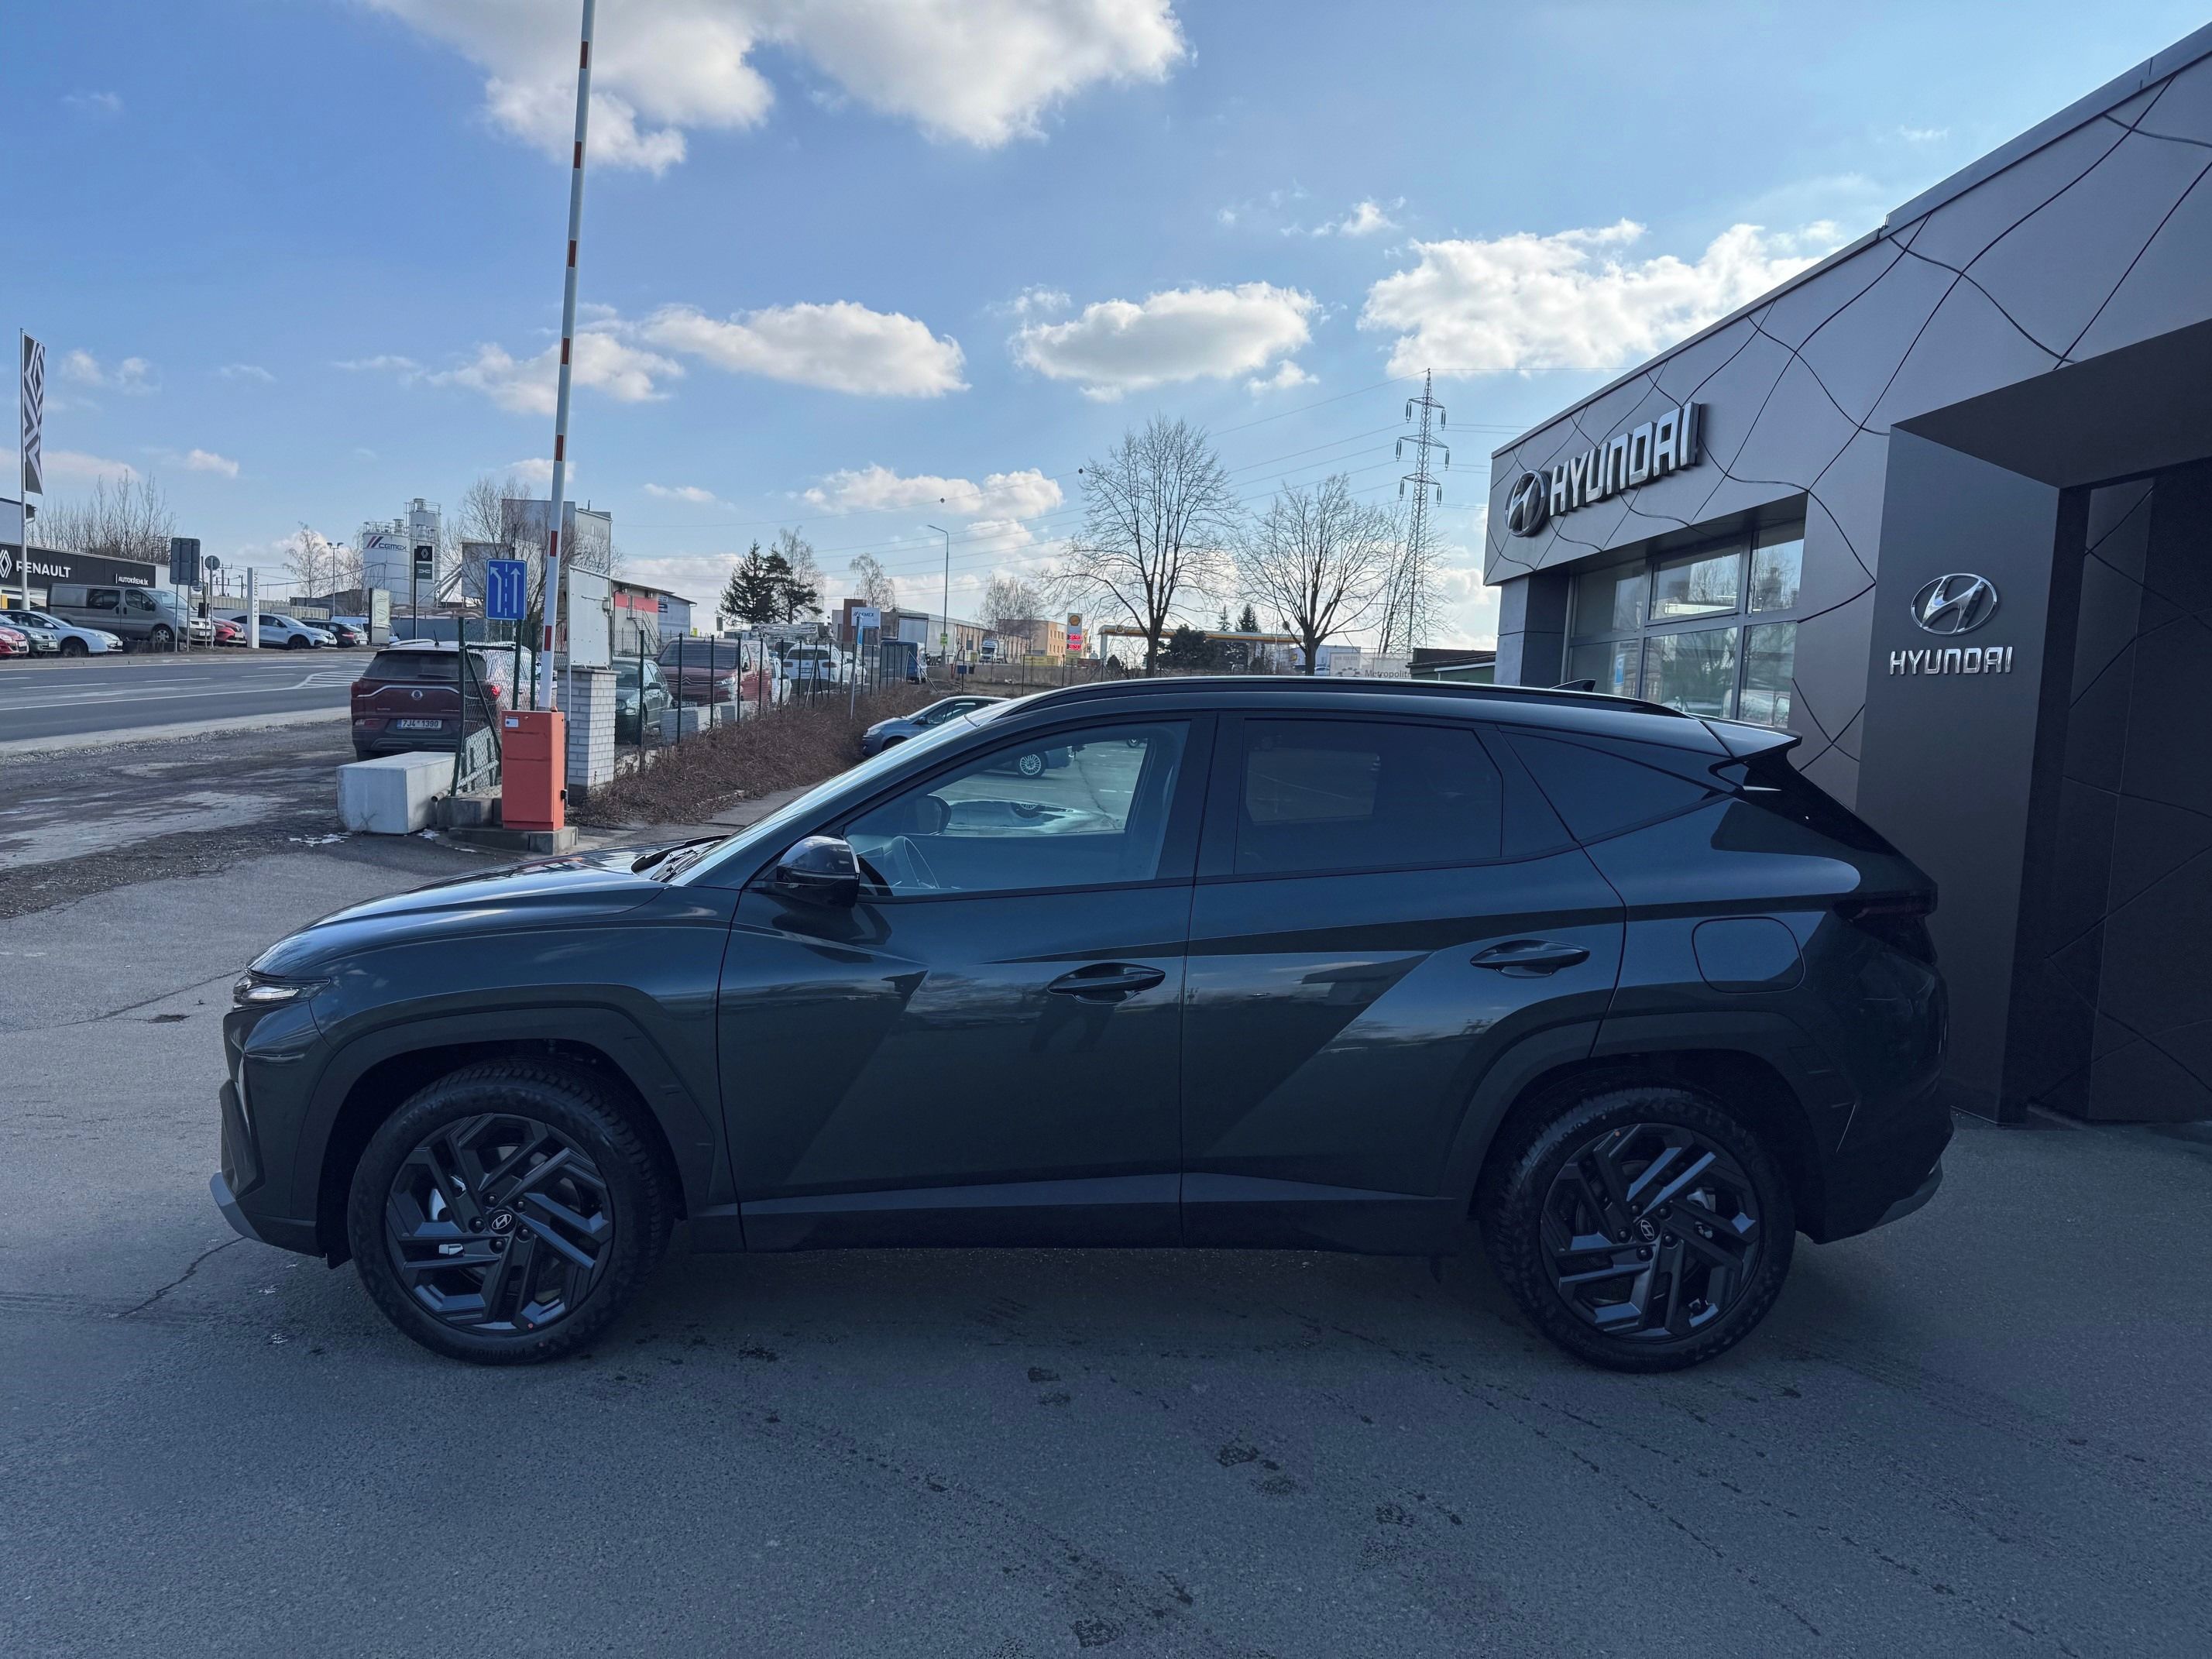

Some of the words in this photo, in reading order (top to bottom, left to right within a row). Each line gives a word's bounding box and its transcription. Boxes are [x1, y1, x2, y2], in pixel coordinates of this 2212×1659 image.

[1550, 402, 1698, 516] HYUNDAI
[16, 560, 71, 579] RENAULT
[1890, 647, 2013, 675] HYUNDAI
